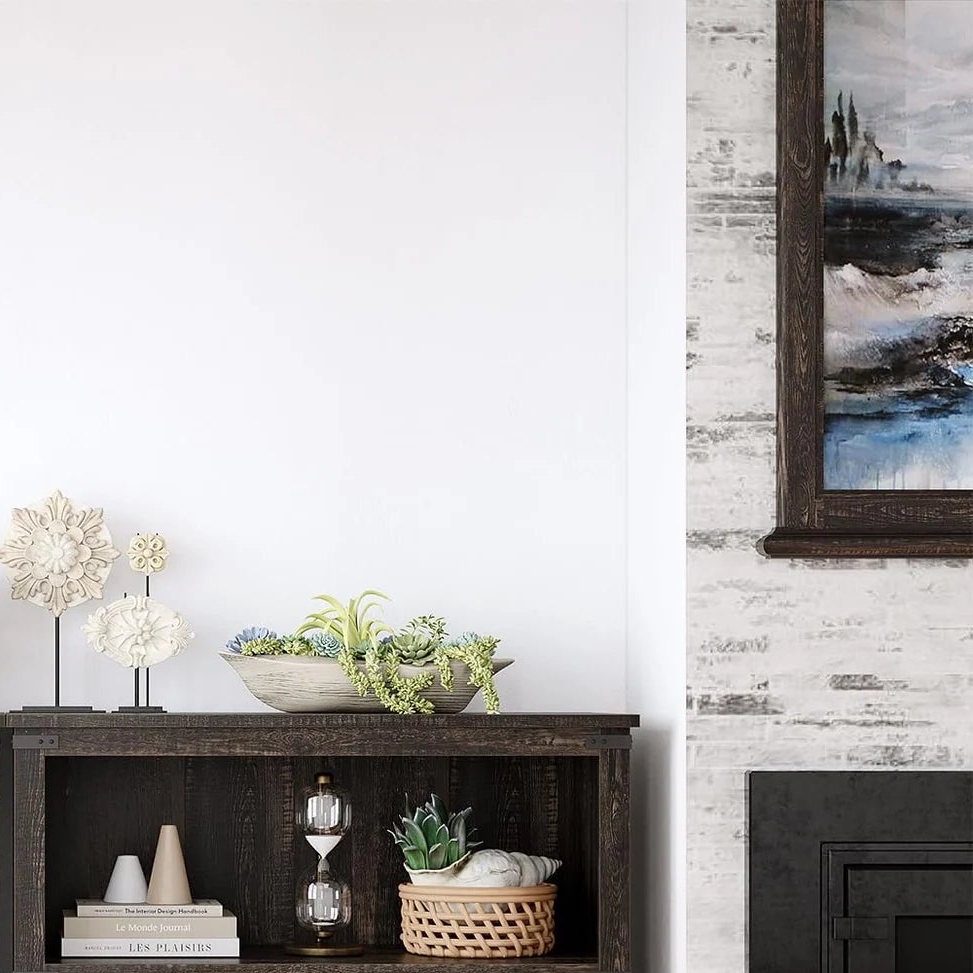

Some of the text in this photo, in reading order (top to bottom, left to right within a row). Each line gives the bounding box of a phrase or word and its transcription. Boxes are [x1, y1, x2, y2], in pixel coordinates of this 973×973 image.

[135, 907, 156, 915] Interior
[157, 907, 176, 916] Design
[178, 907, 208, 915] Handbook
[116, 923, 191, 933] Le Monde Journal
[129, 943, 151, 953] LES
[156, 943, 212, 953] PLAISIRS
